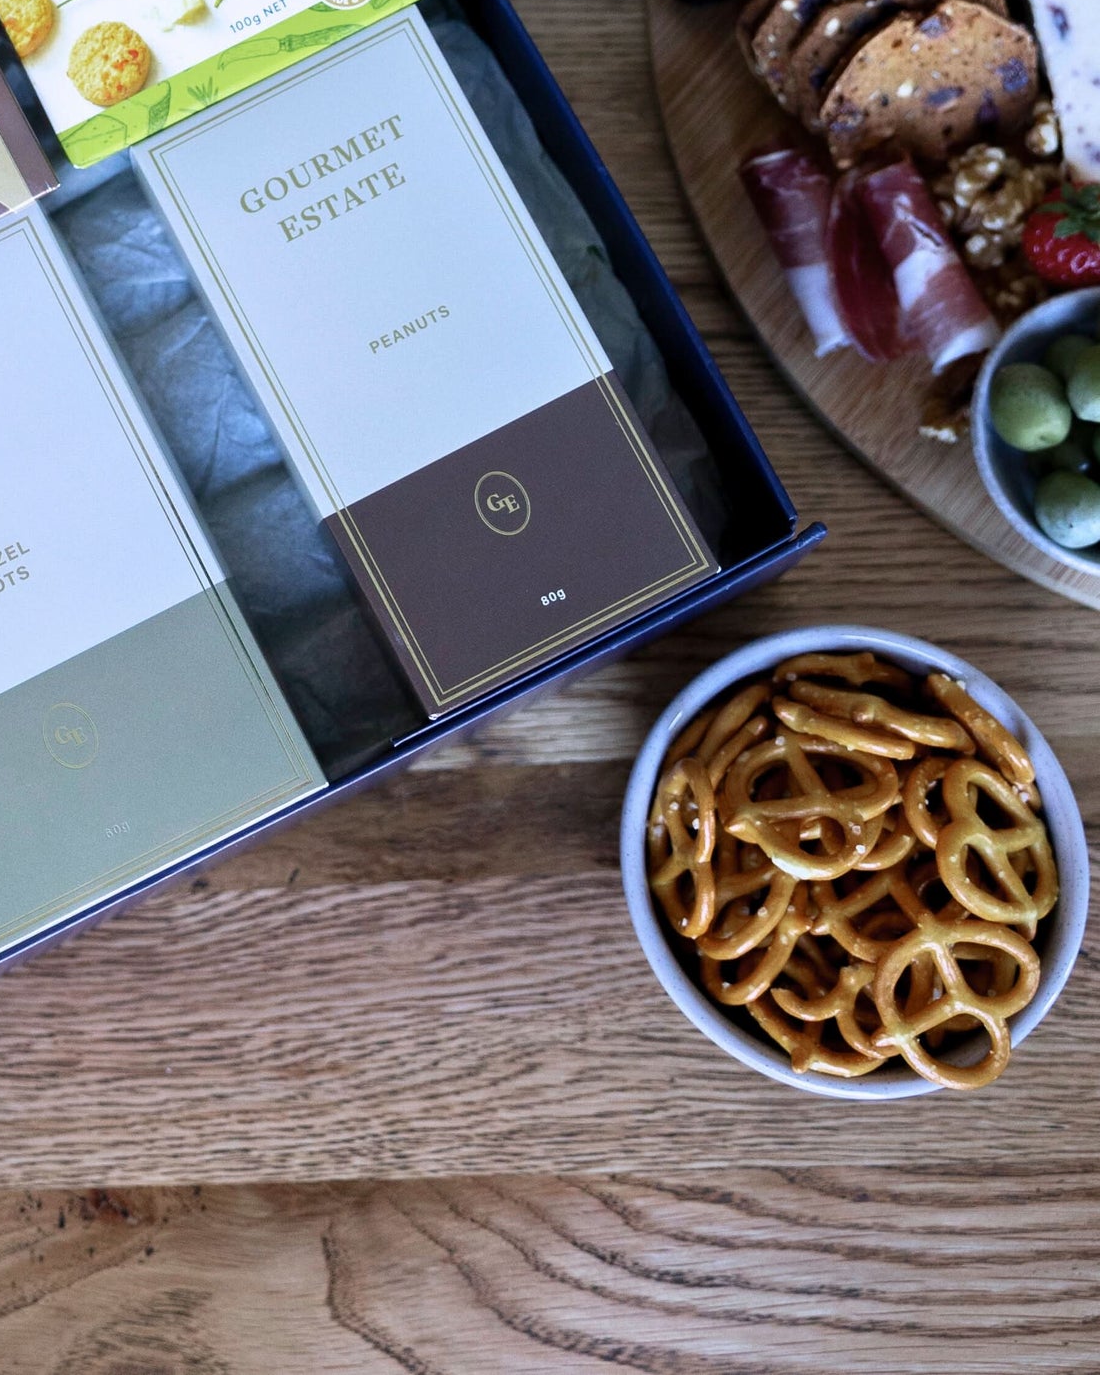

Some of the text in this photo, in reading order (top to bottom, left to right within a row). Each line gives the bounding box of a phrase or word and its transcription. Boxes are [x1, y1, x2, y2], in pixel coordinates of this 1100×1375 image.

[230, 15, 261, 33] 100g
[238, 114, 405, 215] GOURMET
[277, 162, 407, 244] ESTATE
[368, 303, 452, 355] PEANUTS
[539, 586, 567, 607] 80g
